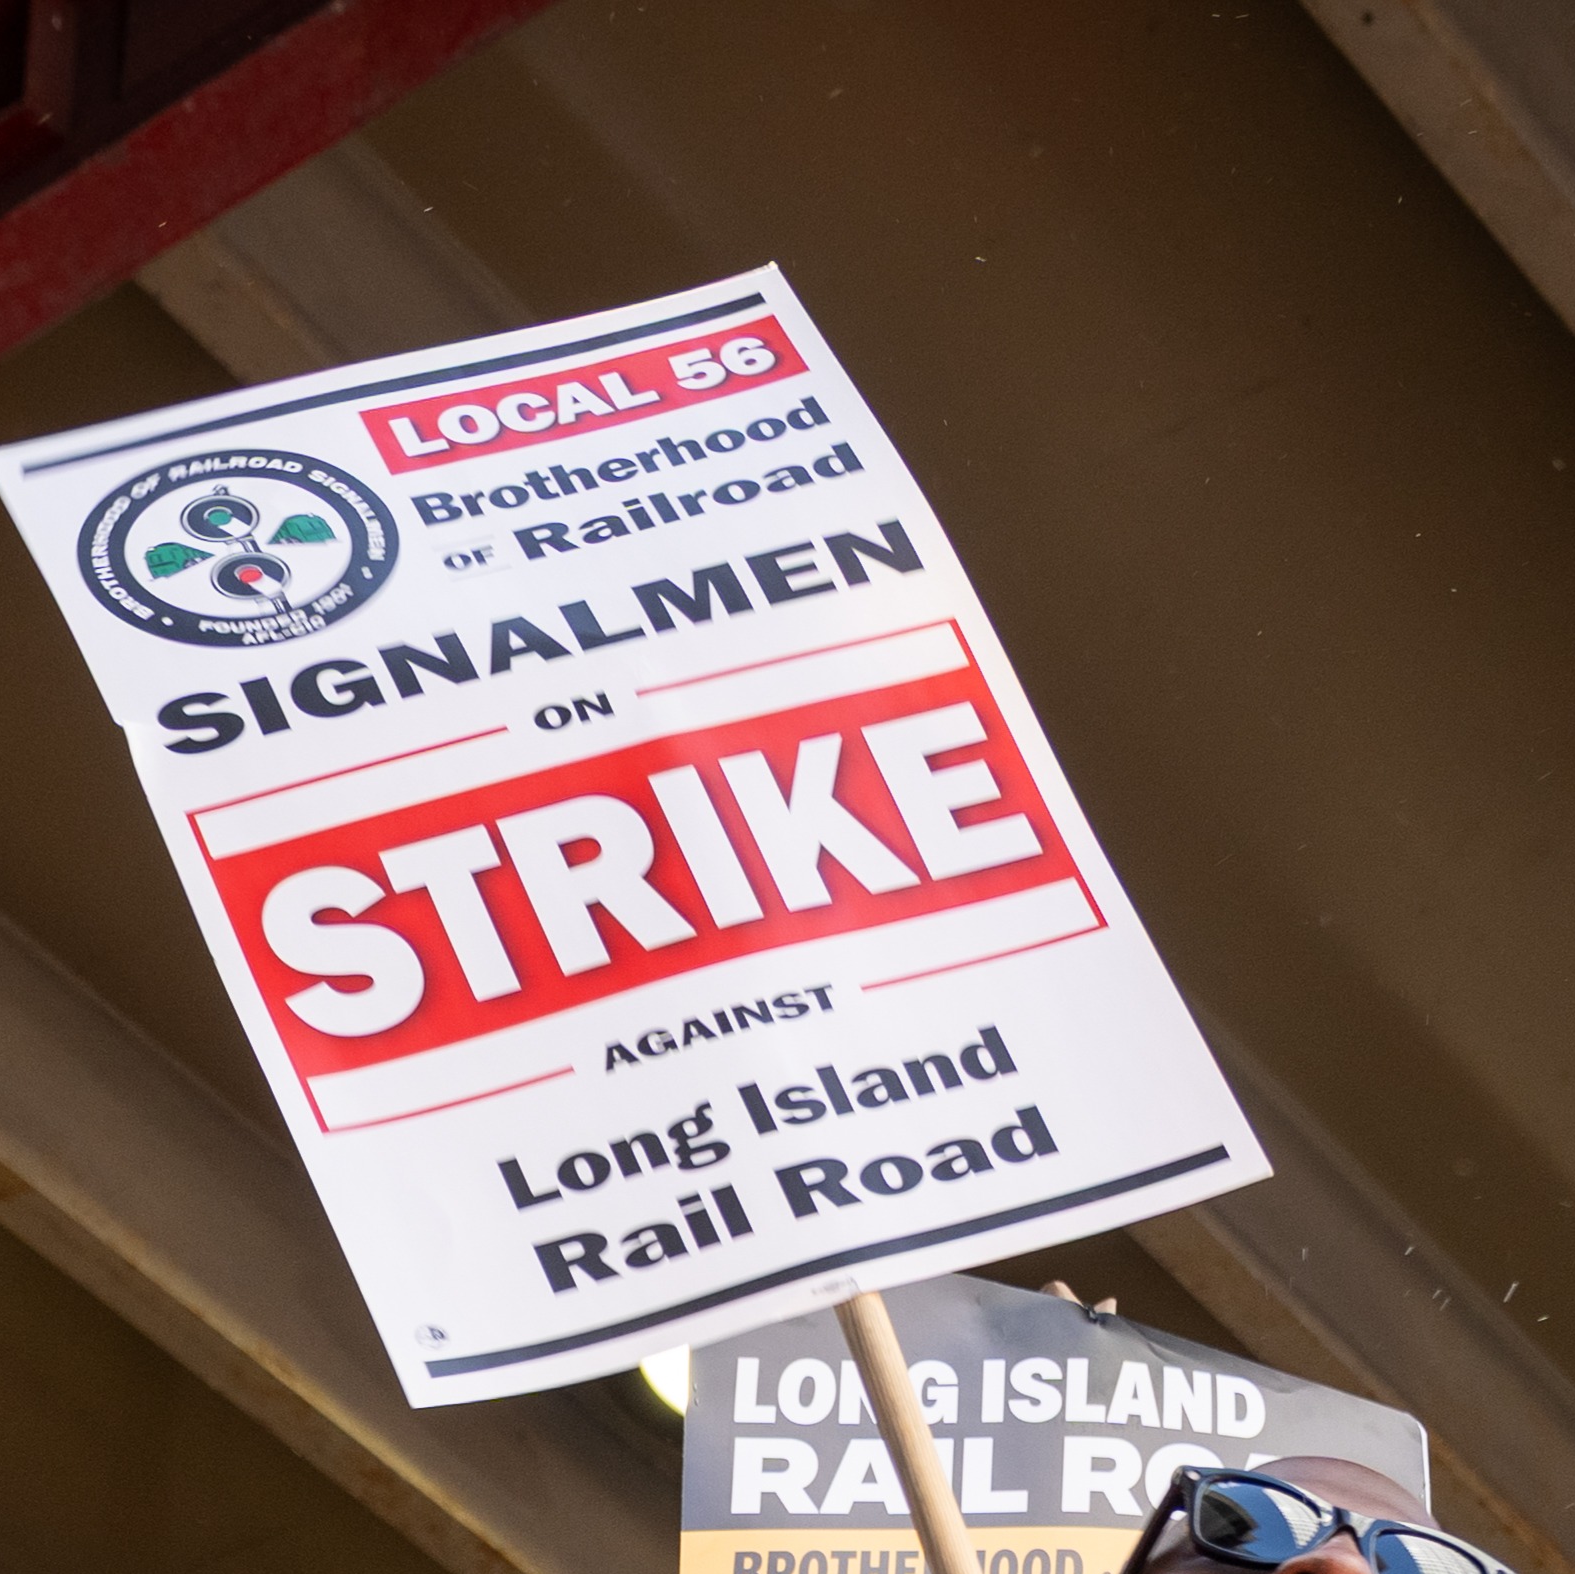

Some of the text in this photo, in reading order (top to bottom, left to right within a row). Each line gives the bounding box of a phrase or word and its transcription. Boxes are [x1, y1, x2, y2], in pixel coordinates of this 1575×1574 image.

[388, 335, 777, 460] LOCAL 56
[409, 397, 832, 528] Brotherhood
[131, 473, 162, 499] OF
[168, 456, 304, 482] RAILROAD
[443, 443, 867, 573] OF Railroad
[157, 519, 926, 756] SIGNALMEN
[534, 692, 614, 733] ON
[261, 701, 1044, 1040] STRIKE
[603, 984, 836, 1072] AGAINST
[499, 1025, 1018, 1210] Long Island
[533, 1106, 1059, 1294] Rail Road
[982, 1357, 1265, 1439] ISLAND
